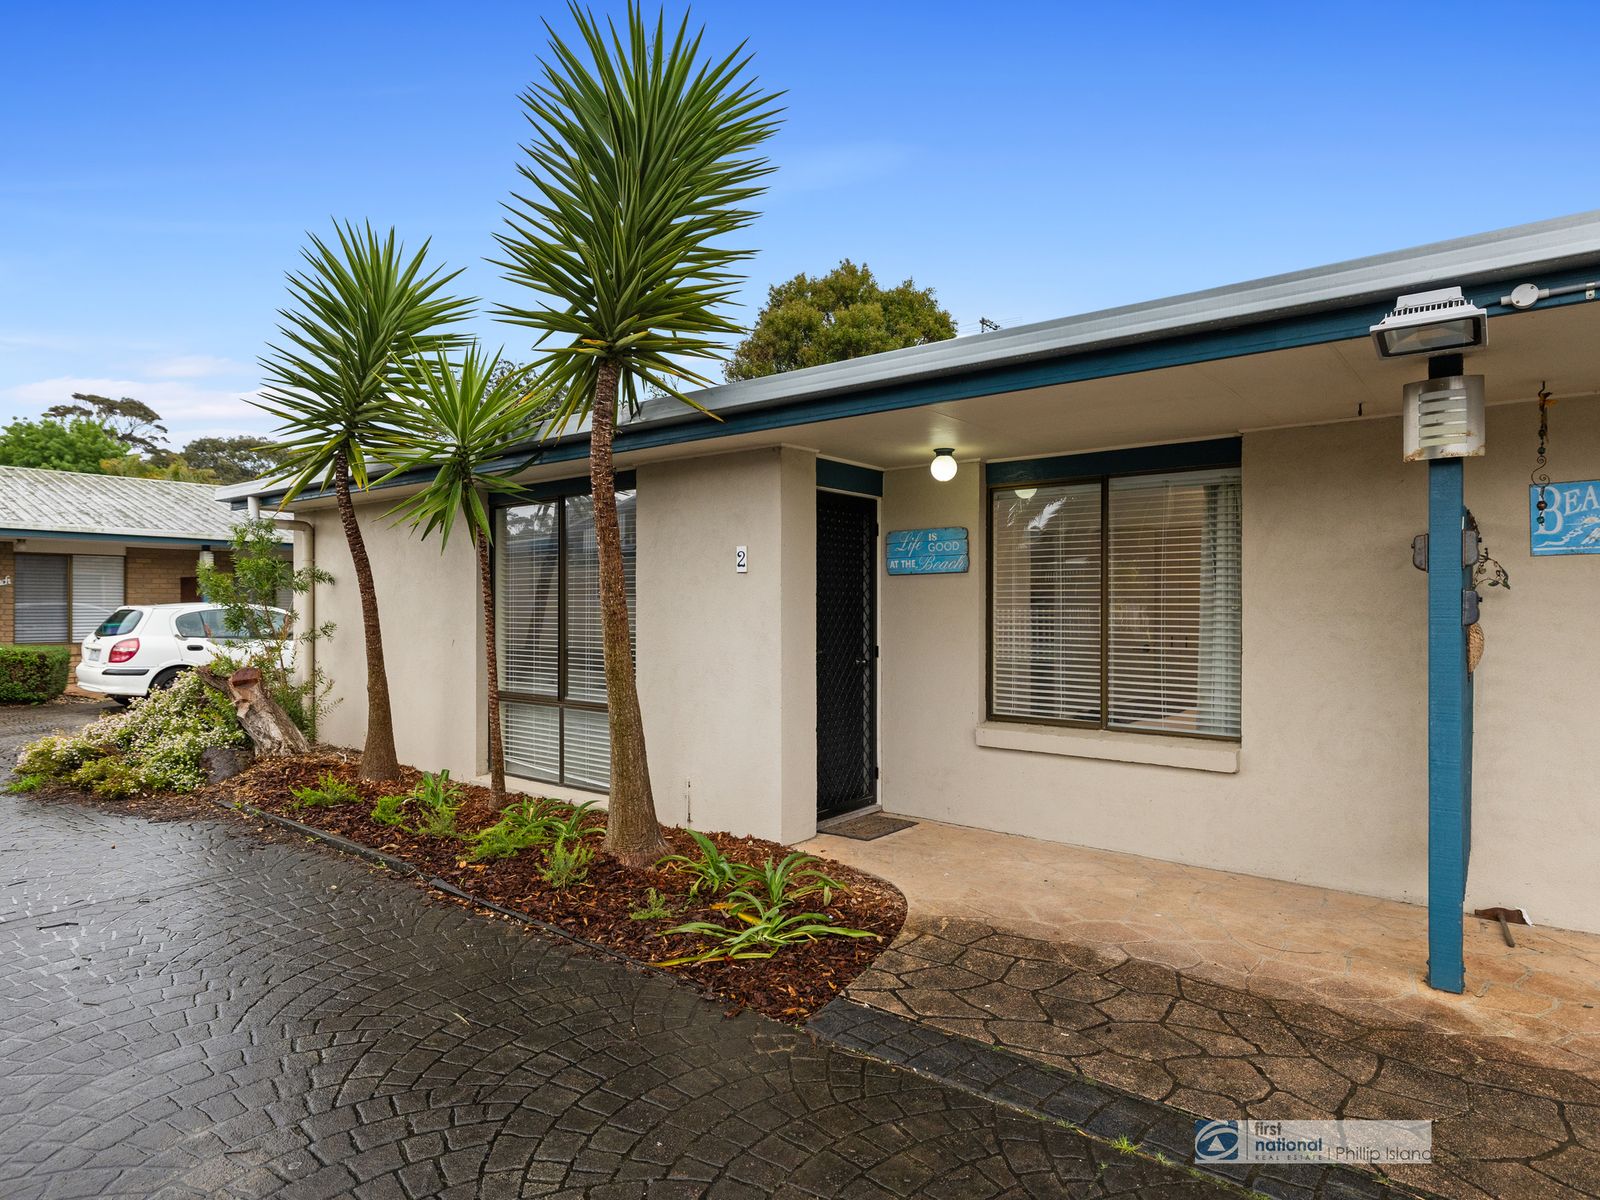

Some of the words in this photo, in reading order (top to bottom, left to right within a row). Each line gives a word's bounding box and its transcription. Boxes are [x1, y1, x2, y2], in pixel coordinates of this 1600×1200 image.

[1534, 485, 1600, 535] BEA
[895, 531, 922, 557] Life
[928, 533, 937, 541] IS
[928, 541, 960, 552] GOOD
[737, 550, 746, 567] 2
[889, 560, 899, 569] AT
[901, 559, 916, 569] THE
[917, 554, 966, 570] Beach
